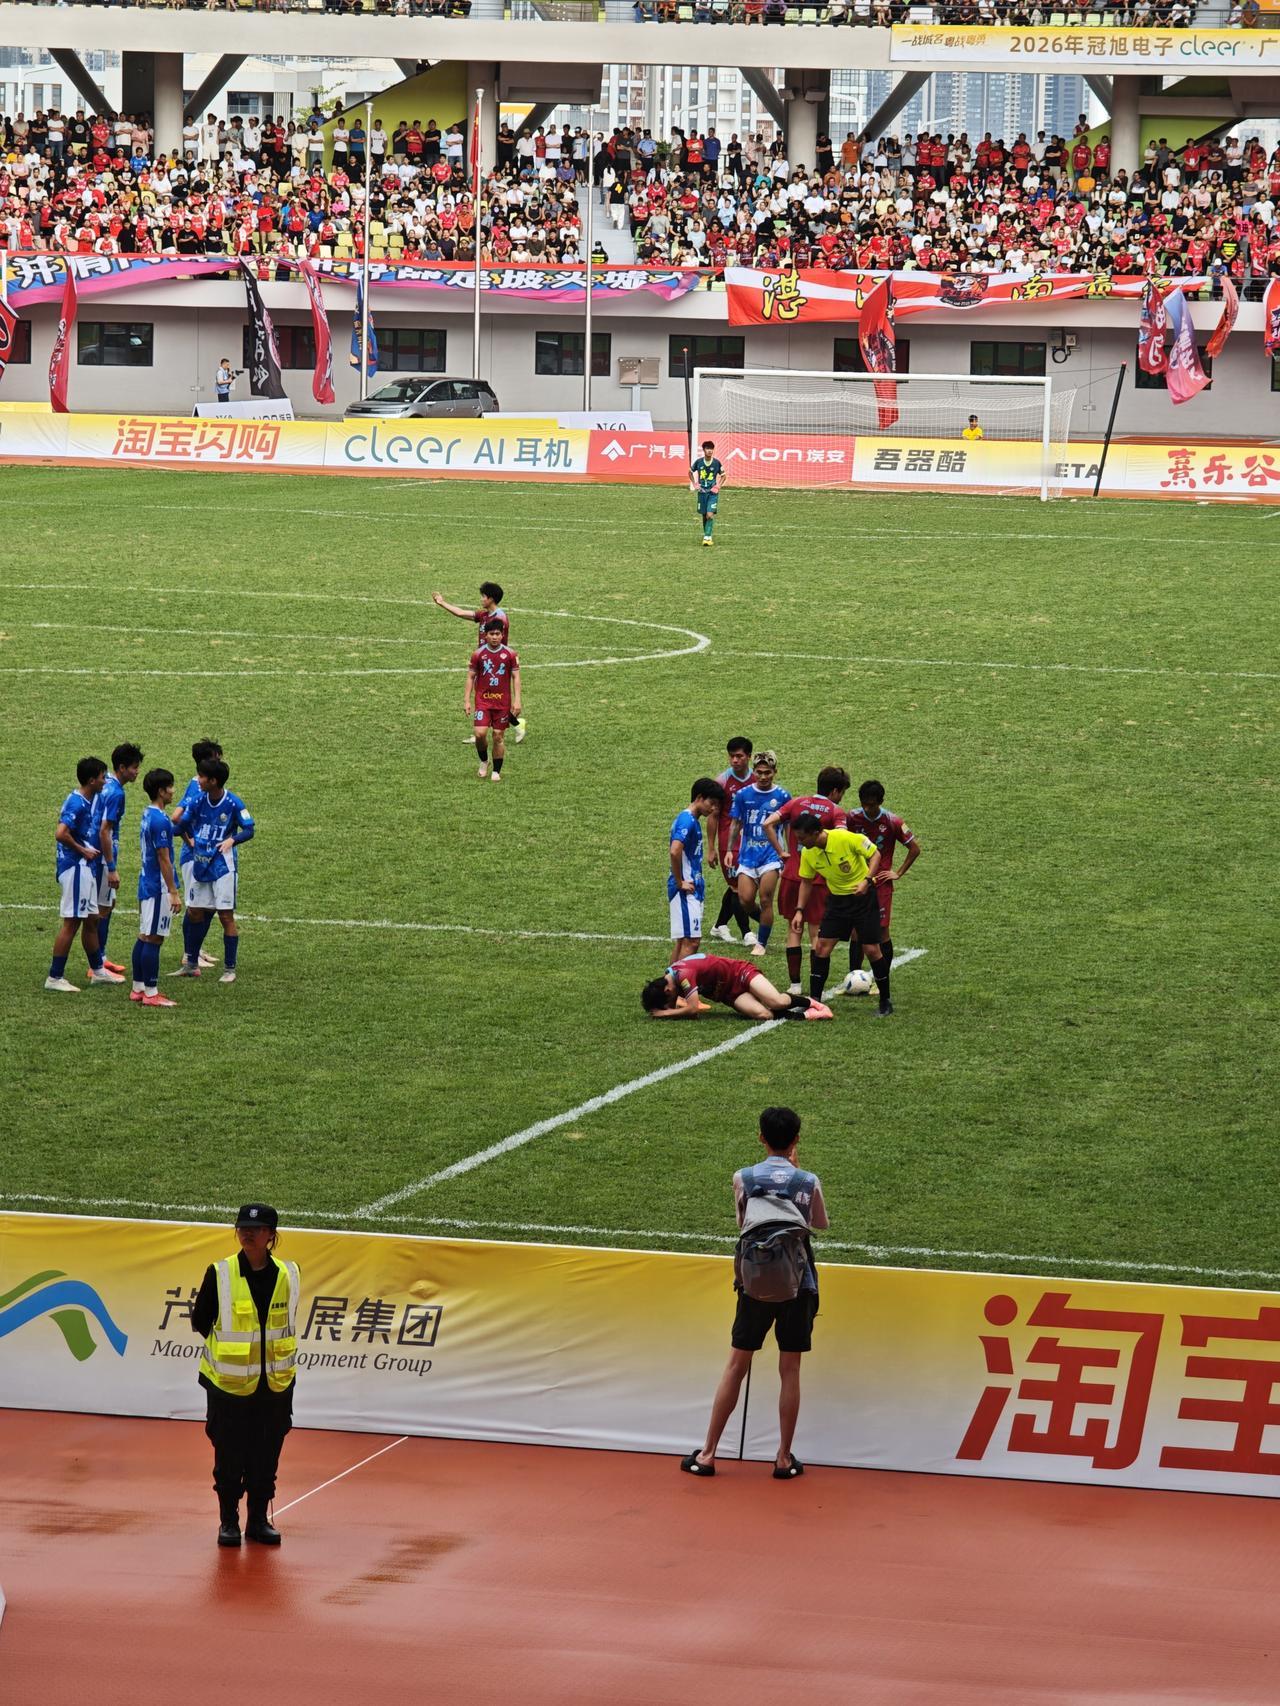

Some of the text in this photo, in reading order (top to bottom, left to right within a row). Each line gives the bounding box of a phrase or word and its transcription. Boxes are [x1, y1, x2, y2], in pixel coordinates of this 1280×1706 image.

[1009, 35, 1174, 57] 2026年冠旭电子
[1179, 34, 1238, 57] cleer
[112, 419, 281, 460] 淘宝闪购
[345, 426, 462, 465] cleer
[628, 443, 704, 460] 广汽昊
[873, 447, 967, 473] 吾器酷
[374, 1353, 433, 1377] Group
